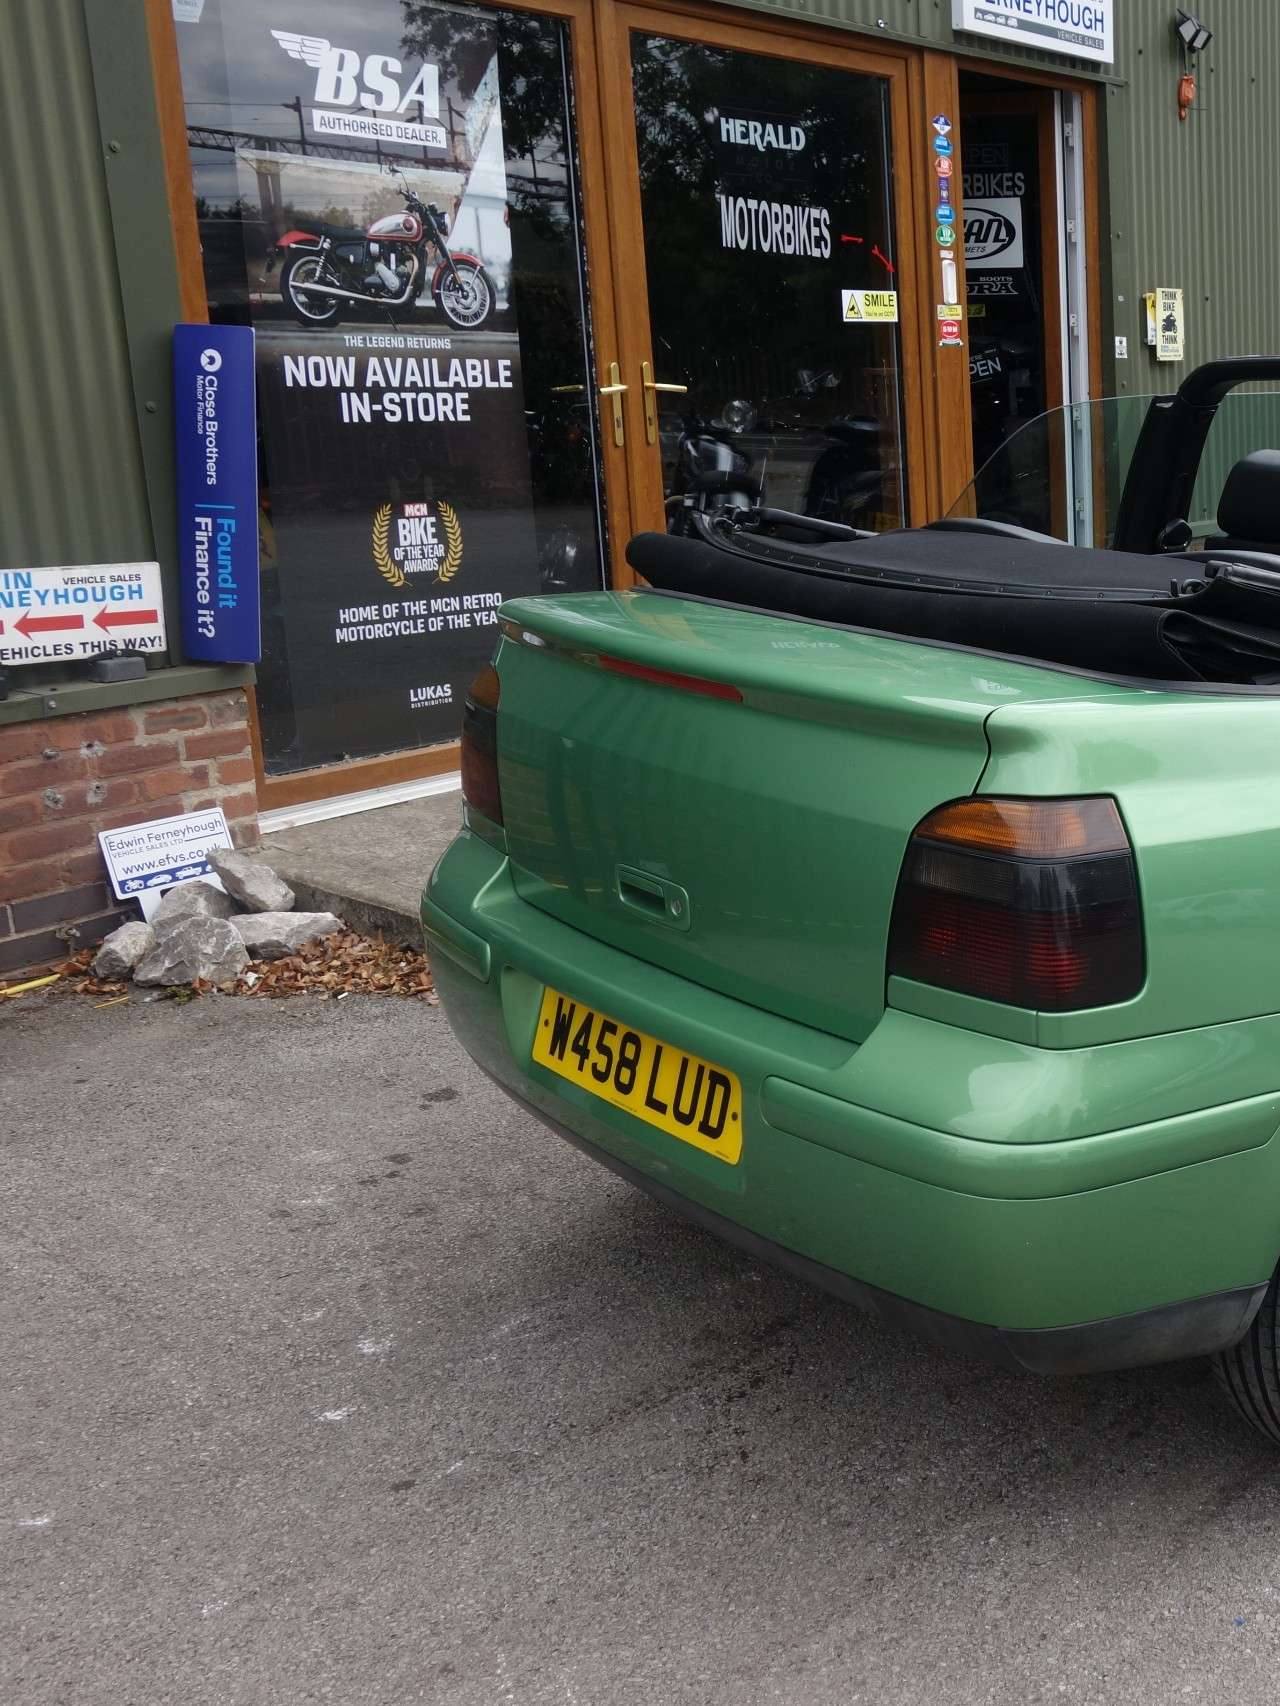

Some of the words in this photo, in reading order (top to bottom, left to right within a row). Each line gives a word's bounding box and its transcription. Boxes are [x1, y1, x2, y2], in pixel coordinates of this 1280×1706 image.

[985, 0, 1104, 33] NEYHOUGH
[1057, 29, 1083, 43] VEHICLE
[1084, 36, 1104, 49] SALES
[314, 47, 441, 119] BSA
[318, 115, 393, 137] AUTHORISED
[720, 117, 806, 152] HERALD
[720, 195, 831, 259] MOTORBIKES
[864, 294, 895, 307] SMILE
[1161, 291, 1178, 300] THINK
[1162, 302, 1175, 311] BIKE
[344, 336, 363, 348] THE
[366, 336, 404, 349] LEGEND
[407, 337, 451, 349] RETURNS
[1161, 334, 1178, 344] THINK
[283, 355, 357, 387] NOW
[365, 357, 512, 388] AVAILABLE
[196, 375, 204, 400] Motor
[205, 375, 218, 418] Close
[197, 402, 205, 435] Finance
[340, 392, 471, 423] IN-STORE
[206, 421, 219, 485] Brothers
[404, 503, 428, 517] MCN
[398, 517, 438, 546] BIKE
[194, 516, 213, 604] Finance
[217, 517, 237, 589] Found
[394, 546, 405, 560] OF
[406, 545, 423, 560] THE
[423, 544, 445, 558] YEAR
[404, 558, 439, 573] AWARDS
[62, 575, 107, 586] VEHICLE
[109, 573, 141, 582] SALES
[0, 583, 143, 608] NEYHOUGH
[218, 594, 237, 609] it
[339, 605, 379, 624] HOME
[383, 603, 400, 619] OF
[401, 600, 428, 616] THE
[431, 597, 460, 613] MCN
[462, 592, 502, 610] RETRO
[197, 610, 216, 638] it?
[335, 618, 425, 643] MOTORCYCLE
[428, 616, 444, 632] OF
[446, 613, 471, 630] THE
[80, 640, 118, 654] THIS
[123, 635, 163, 650] WAY!
[410, 684, 452, 702] LUKAS
[411, 697, 453, 709] DISTRIBUTION
[109, 836, 146, 852] Edwin
[148, 819, 223, 843] Ferneyhough
[112, 847, 144, 859] VEHICLE
[146, 841, 169, 852] SALES
[549, 997, 642, 1095] W458
[645, 1045, 731, 1140] LUD
